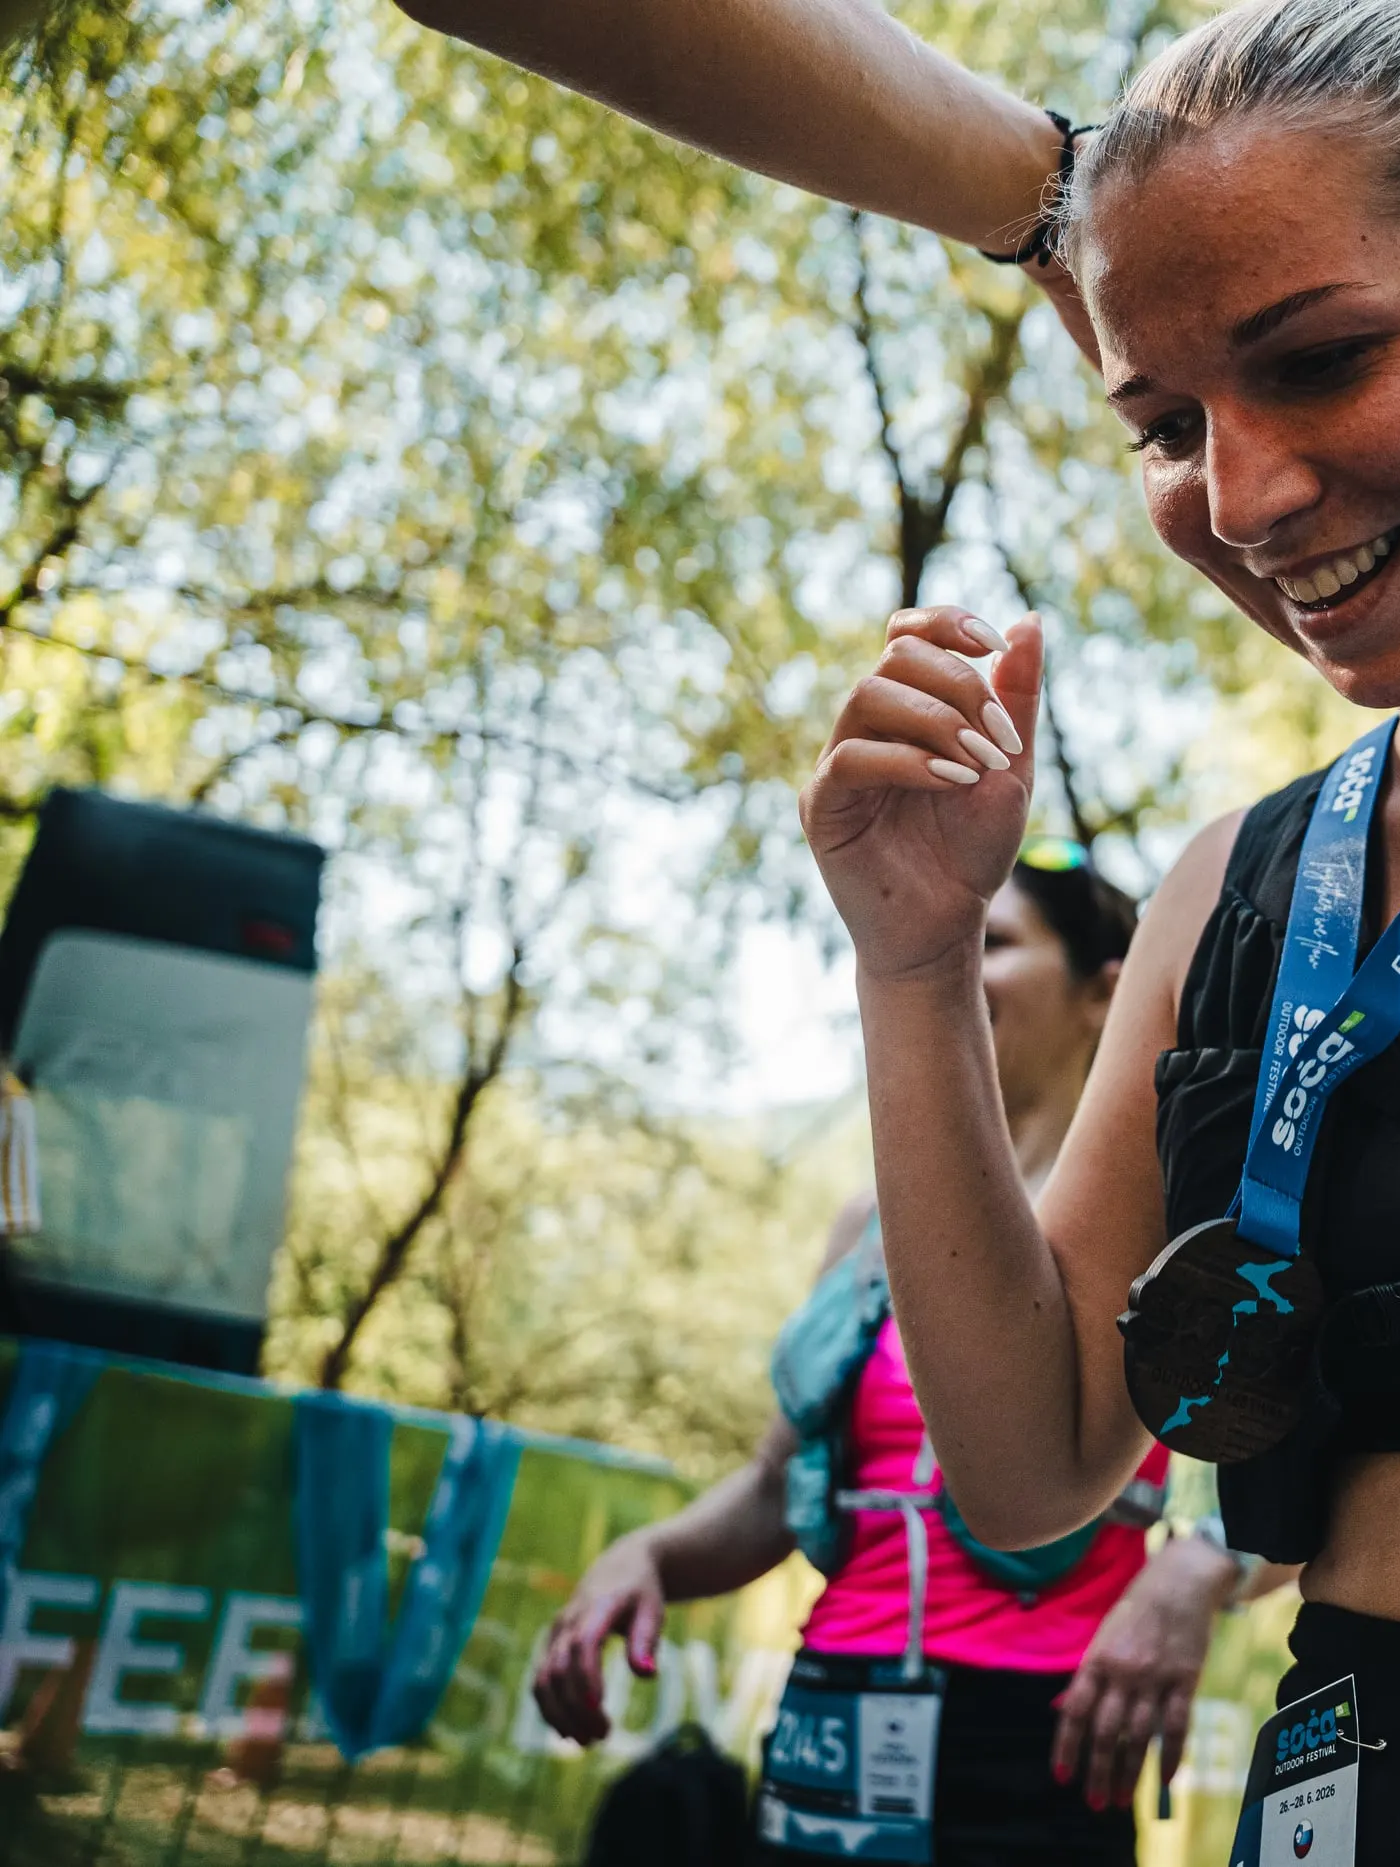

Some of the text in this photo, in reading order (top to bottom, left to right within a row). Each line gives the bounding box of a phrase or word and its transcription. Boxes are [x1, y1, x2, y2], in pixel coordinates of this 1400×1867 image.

[1273, 1000, 1294, 1057] OUTDOOR
[1271, 1031, 1355, 1153] soča
[1293, 1051, 1365, 1157] OUTDOOR FESTIVAL
[0, 1568, 335, 1740] FEE
[1275, 1743, 1337, 1775] OUTDOOR FESTIVAL
[1307, 1791, 1314, 1805] 6.
[1315, 1783, 1336, 1802] 2026
